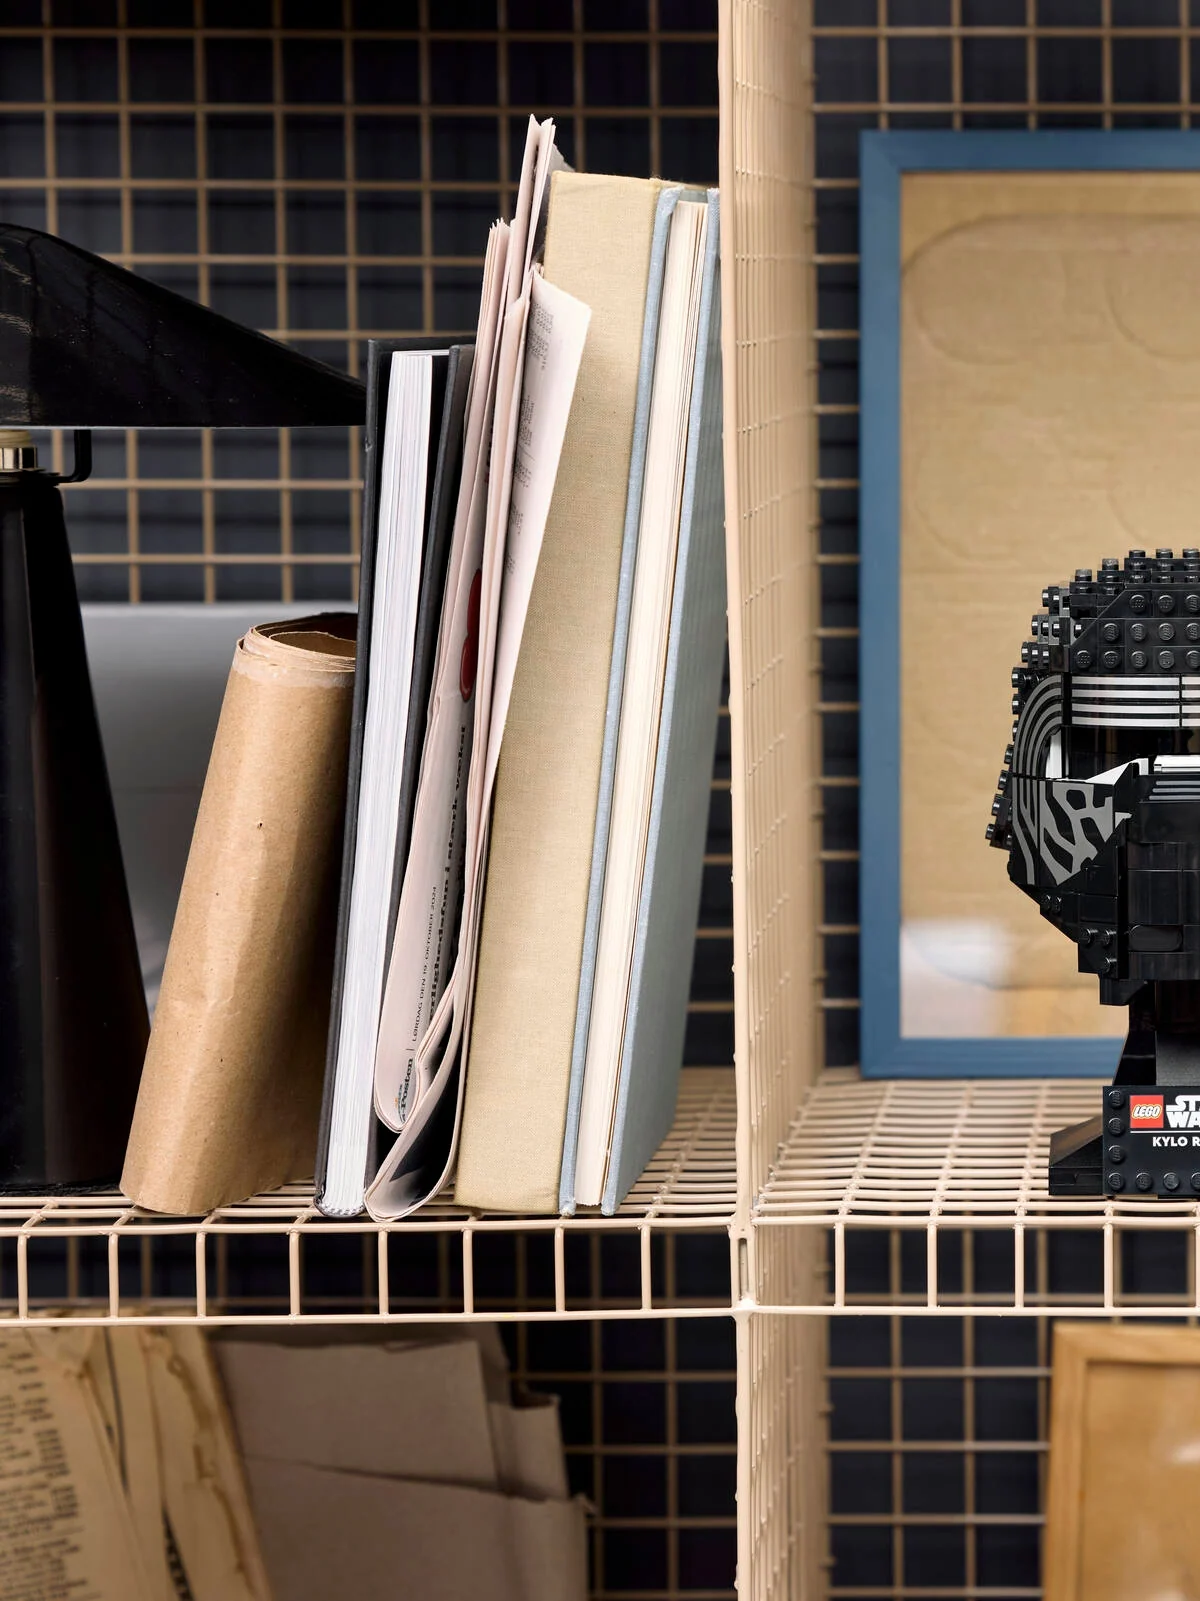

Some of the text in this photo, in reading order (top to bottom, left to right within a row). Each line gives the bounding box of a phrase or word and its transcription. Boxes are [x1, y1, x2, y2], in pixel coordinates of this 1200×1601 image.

[412, 1001, 423, 1042] LØRDAG
[425, 914, 434, 960] OKTOBER
[1132, 1104, 1162, 1119] LEGO
[1152, 1136, 1188, 1147] KYLO
